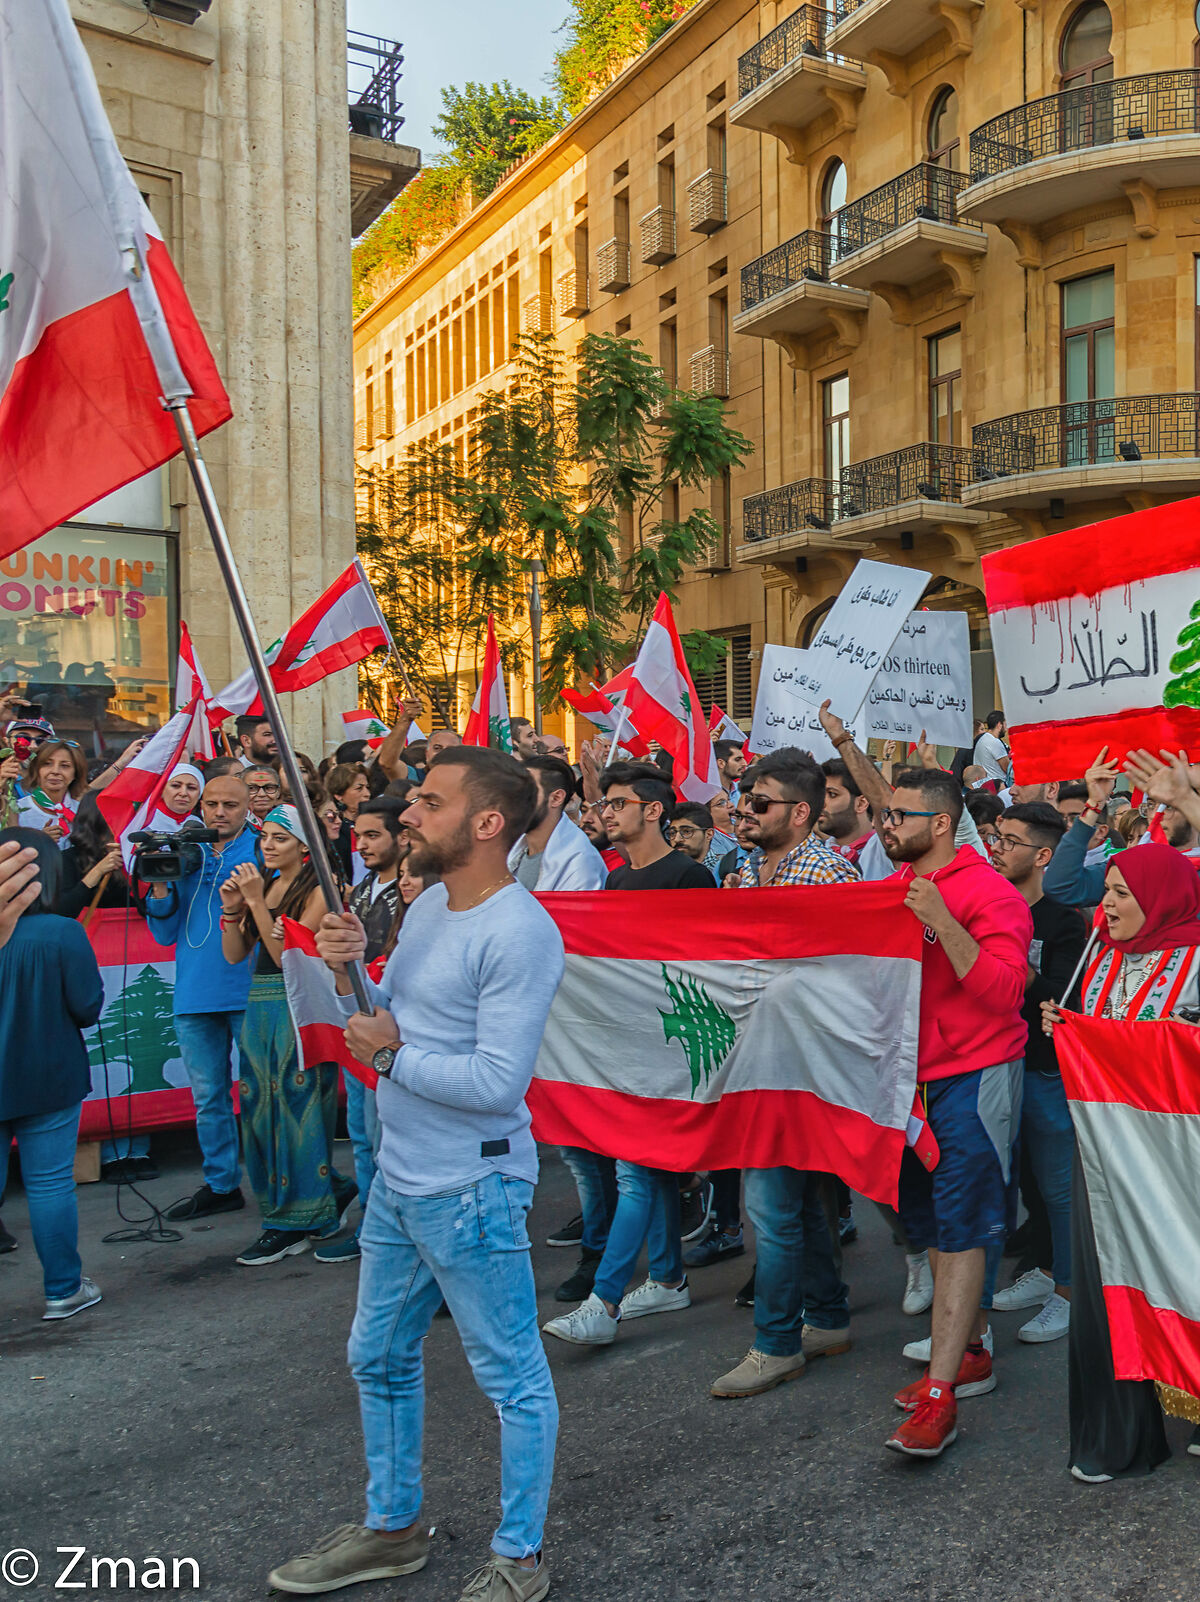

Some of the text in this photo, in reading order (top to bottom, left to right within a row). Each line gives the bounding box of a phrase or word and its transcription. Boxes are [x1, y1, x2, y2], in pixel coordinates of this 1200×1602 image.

[880, 656, 951, 676] OS thirteen
[869, 687, 906, 705] الحاكمين
